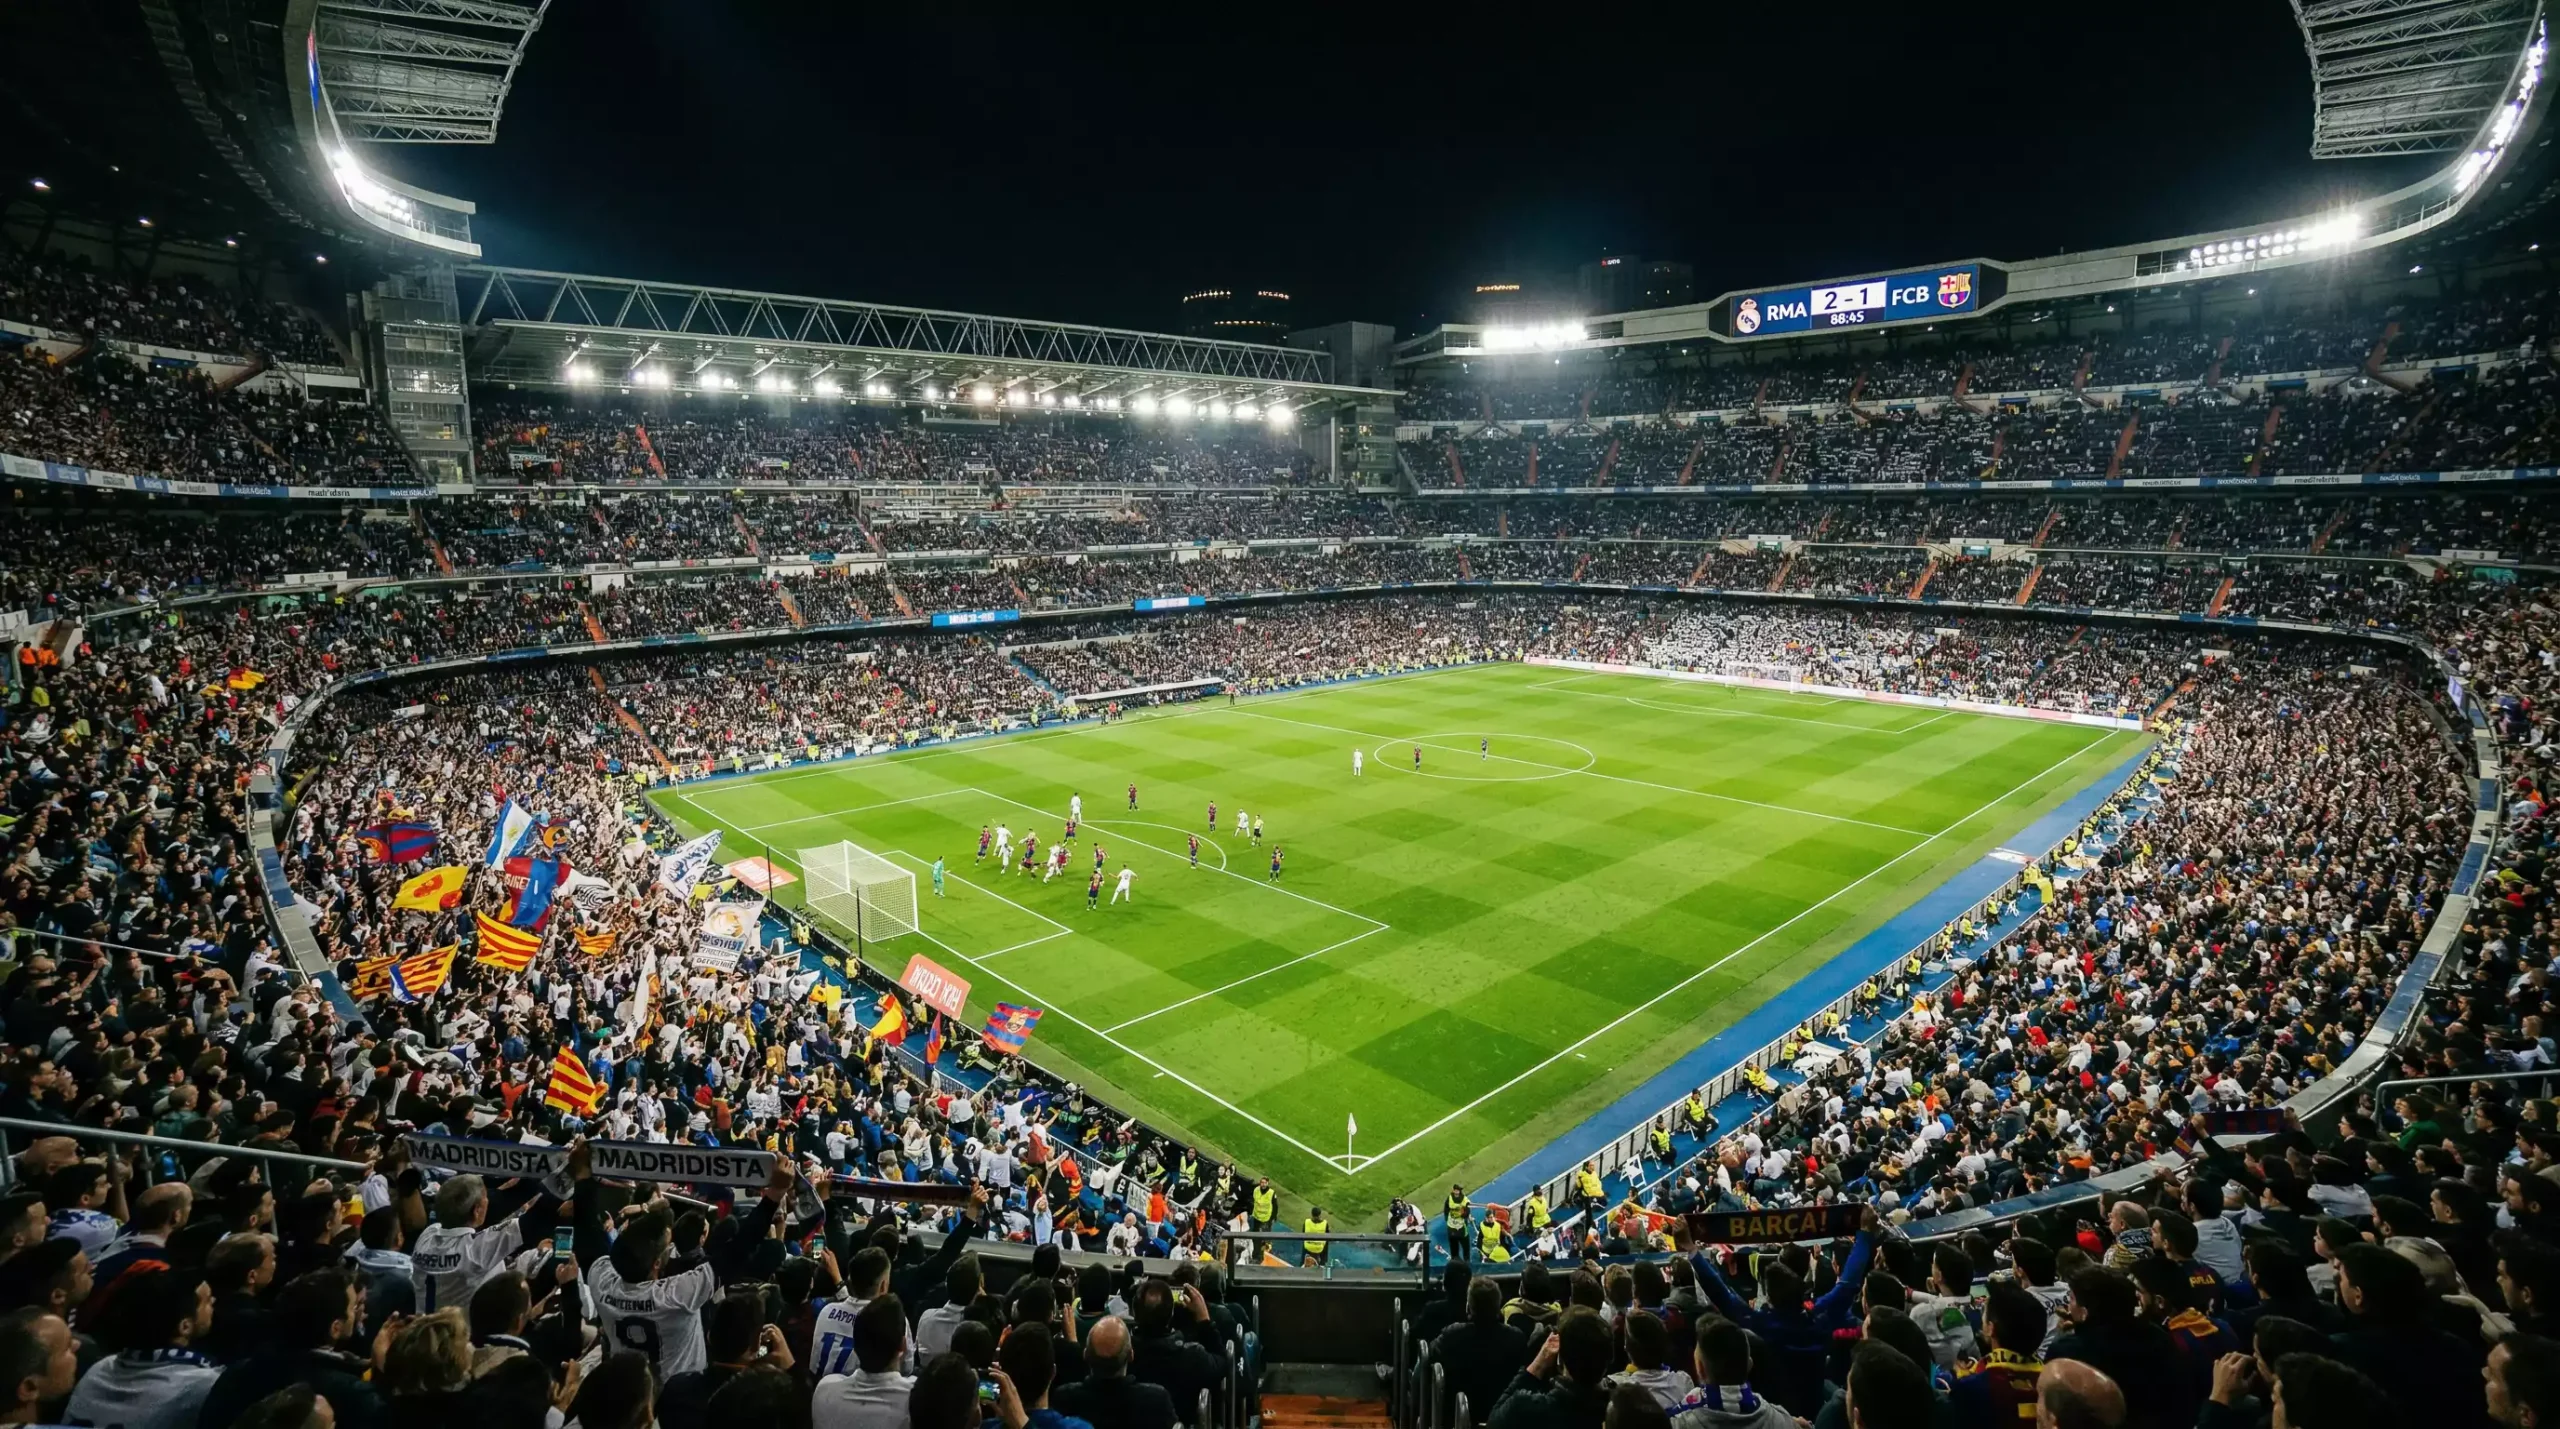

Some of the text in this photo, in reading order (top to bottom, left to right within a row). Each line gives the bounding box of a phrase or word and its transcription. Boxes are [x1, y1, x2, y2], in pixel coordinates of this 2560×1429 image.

[1767, 302, 1807, 321] RMA
[1891, 286, 1930, 306] FCB
[1830, 311, 1864, 325] 88:45
[410, 1142, 550, 1173] MADRIDISTA
[599, 1147, 765, 1179] MADRIDISTA
[1729, 1211, 1828, 1239] BARÇA!
